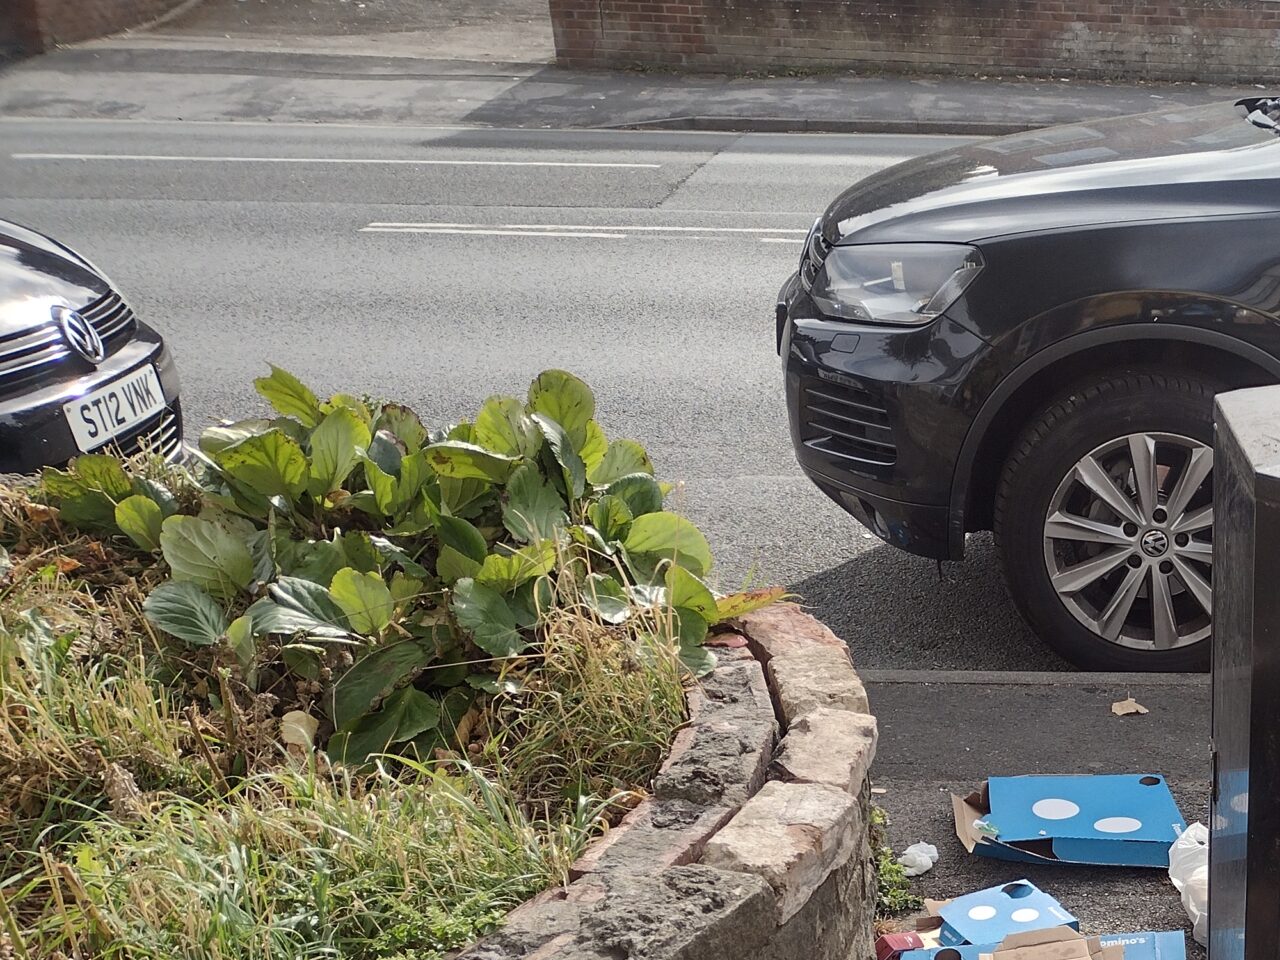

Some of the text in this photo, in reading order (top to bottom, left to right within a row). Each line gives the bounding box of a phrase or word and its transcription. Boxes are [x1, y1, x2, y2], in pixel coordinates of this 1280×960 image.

[79, 374, 157, 438] ST12 VNK
[1100, 937, 1146, 948] omino's
